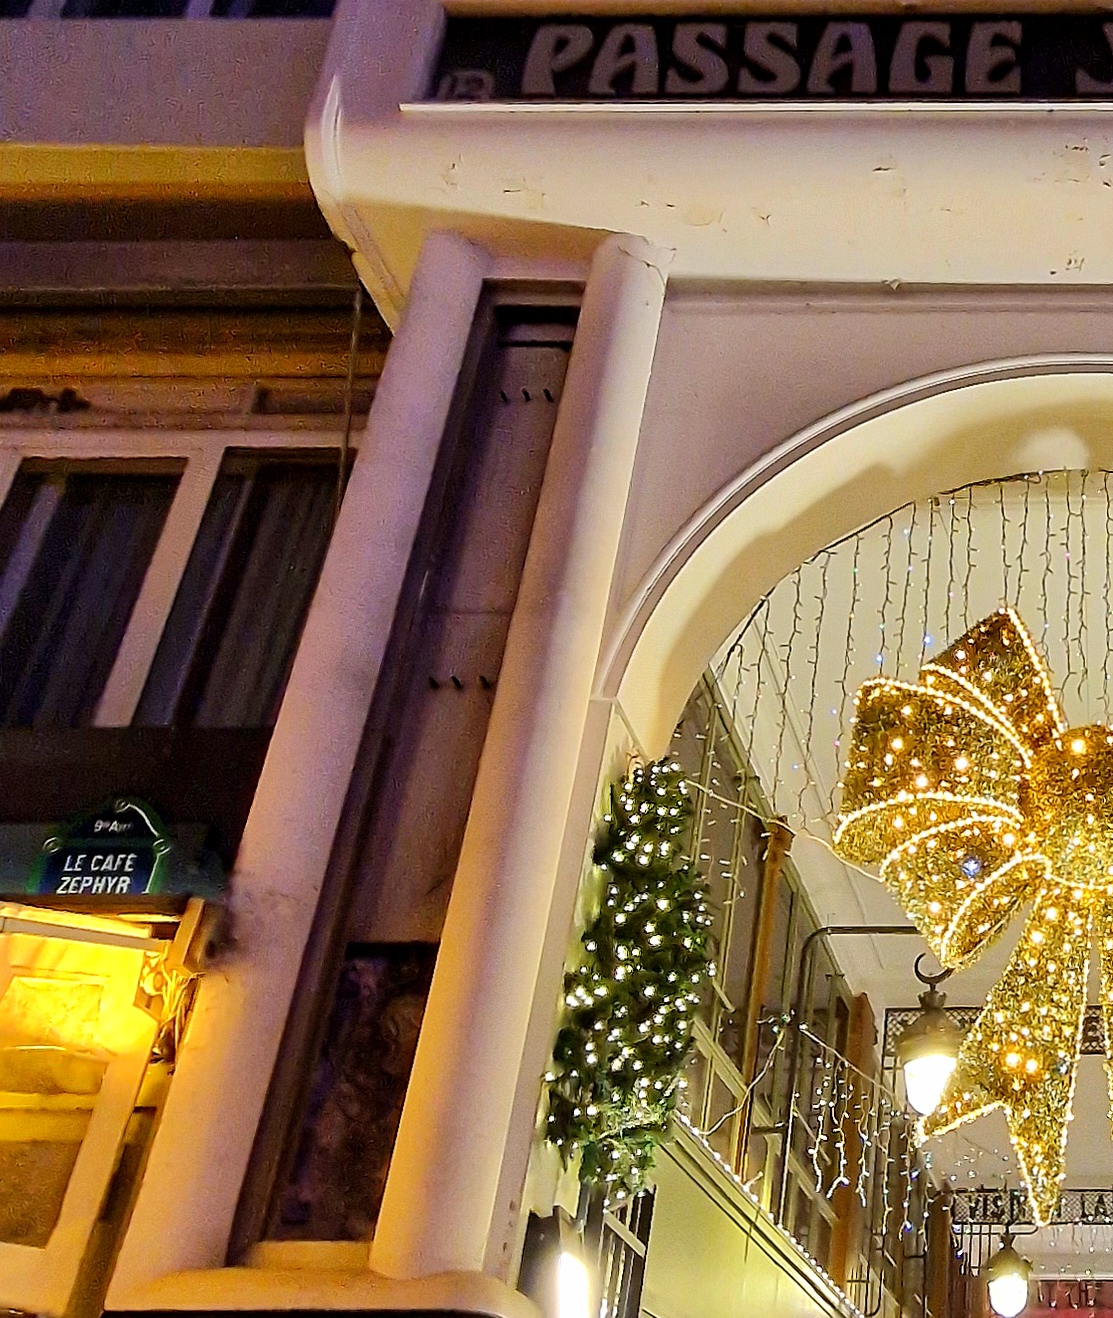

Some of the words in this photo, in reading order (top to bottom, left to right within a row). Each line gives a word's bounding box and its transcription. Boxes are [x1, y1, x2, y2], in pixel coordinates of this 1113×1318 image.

[520, 21, 1022, 96] PASSAGE
[63, 854, 87, 872] LE
[91, 853, 138, 872] CAFÉ
[56, 876, 132, 895] ZEPHYR
